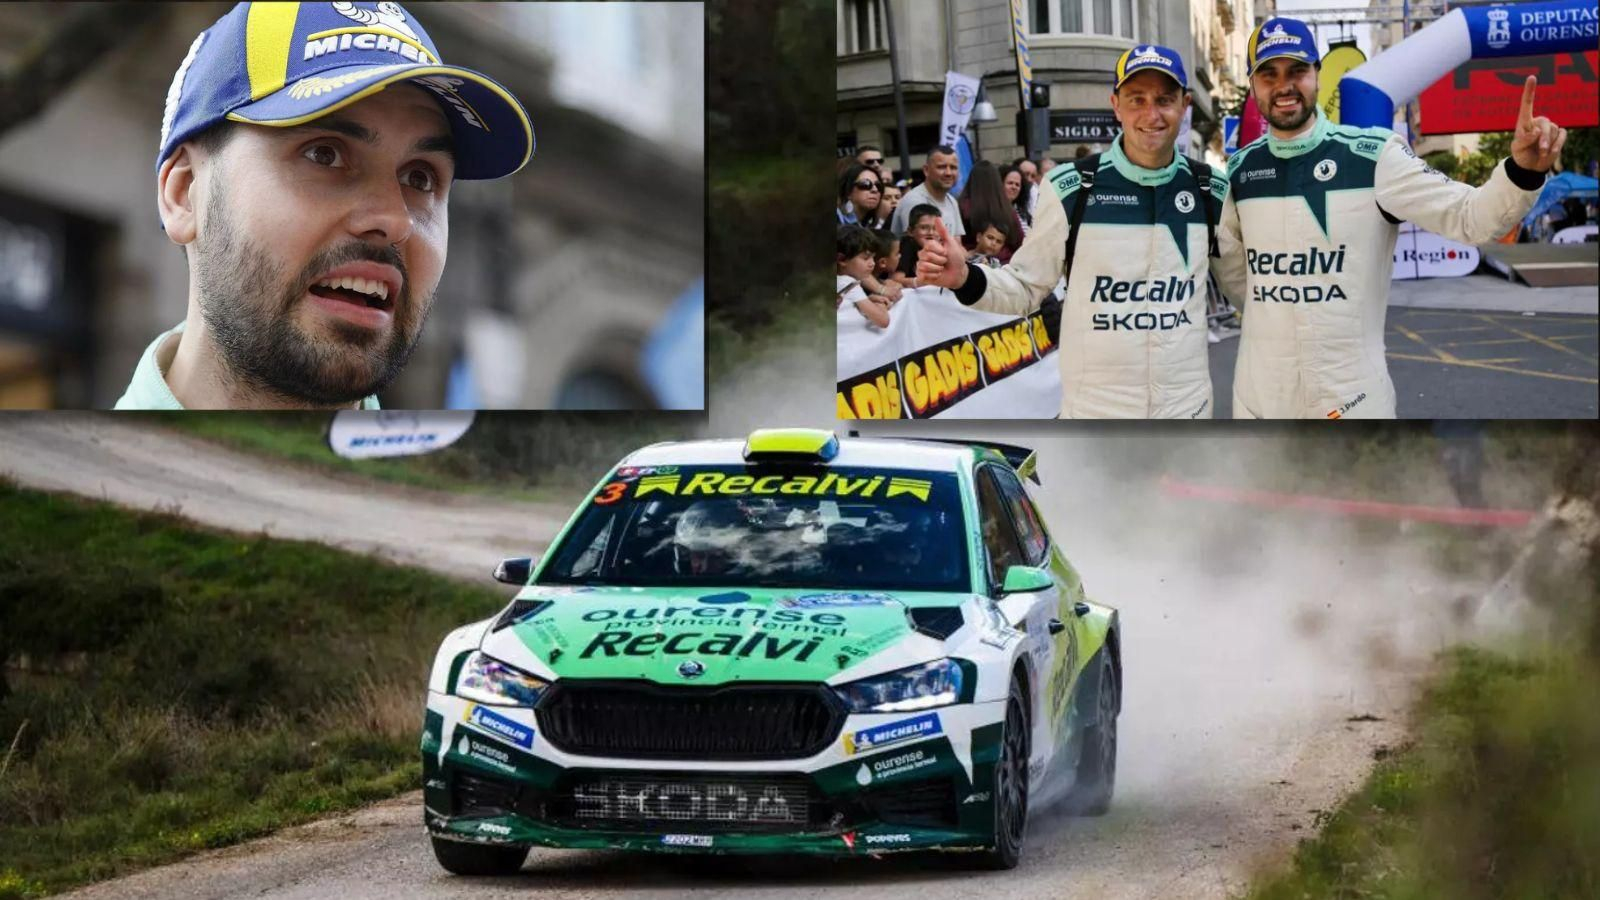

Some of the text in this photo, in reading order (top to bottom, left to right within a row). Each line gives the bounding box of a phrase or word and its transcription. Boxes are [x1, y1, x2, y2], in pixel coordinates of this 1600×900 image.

[1055, 126, 1101, 138] SIGLO
[1356, 142, 1378, 151] OMP
[1058, 176, 1080, 190] OMP
[1247, 167, 1276, 178] ourense
[1096, 194, 1138, 202] ourense
[1247, 245, 1346, 276] Recalvi
[1090, 275, 1195, 304] Recalvi
[904, 340, 978, 414] GADIS
[978, 320, 1033, 377] GADIS
[594, 481, 628, 504] 3
[680, 472, 886, 498] Recalvi
[582, 604, 846, 627] ourense
[604, 617, 741, 631] provincia
[579, 631, 824, 662] Recalvi
[482, 716, 527, 741] MICHELIN
[873, 720, 933, 743] MICHELIN
[471, 740, 509, 762] ourense
[874, 750, 924, 771] ourense
